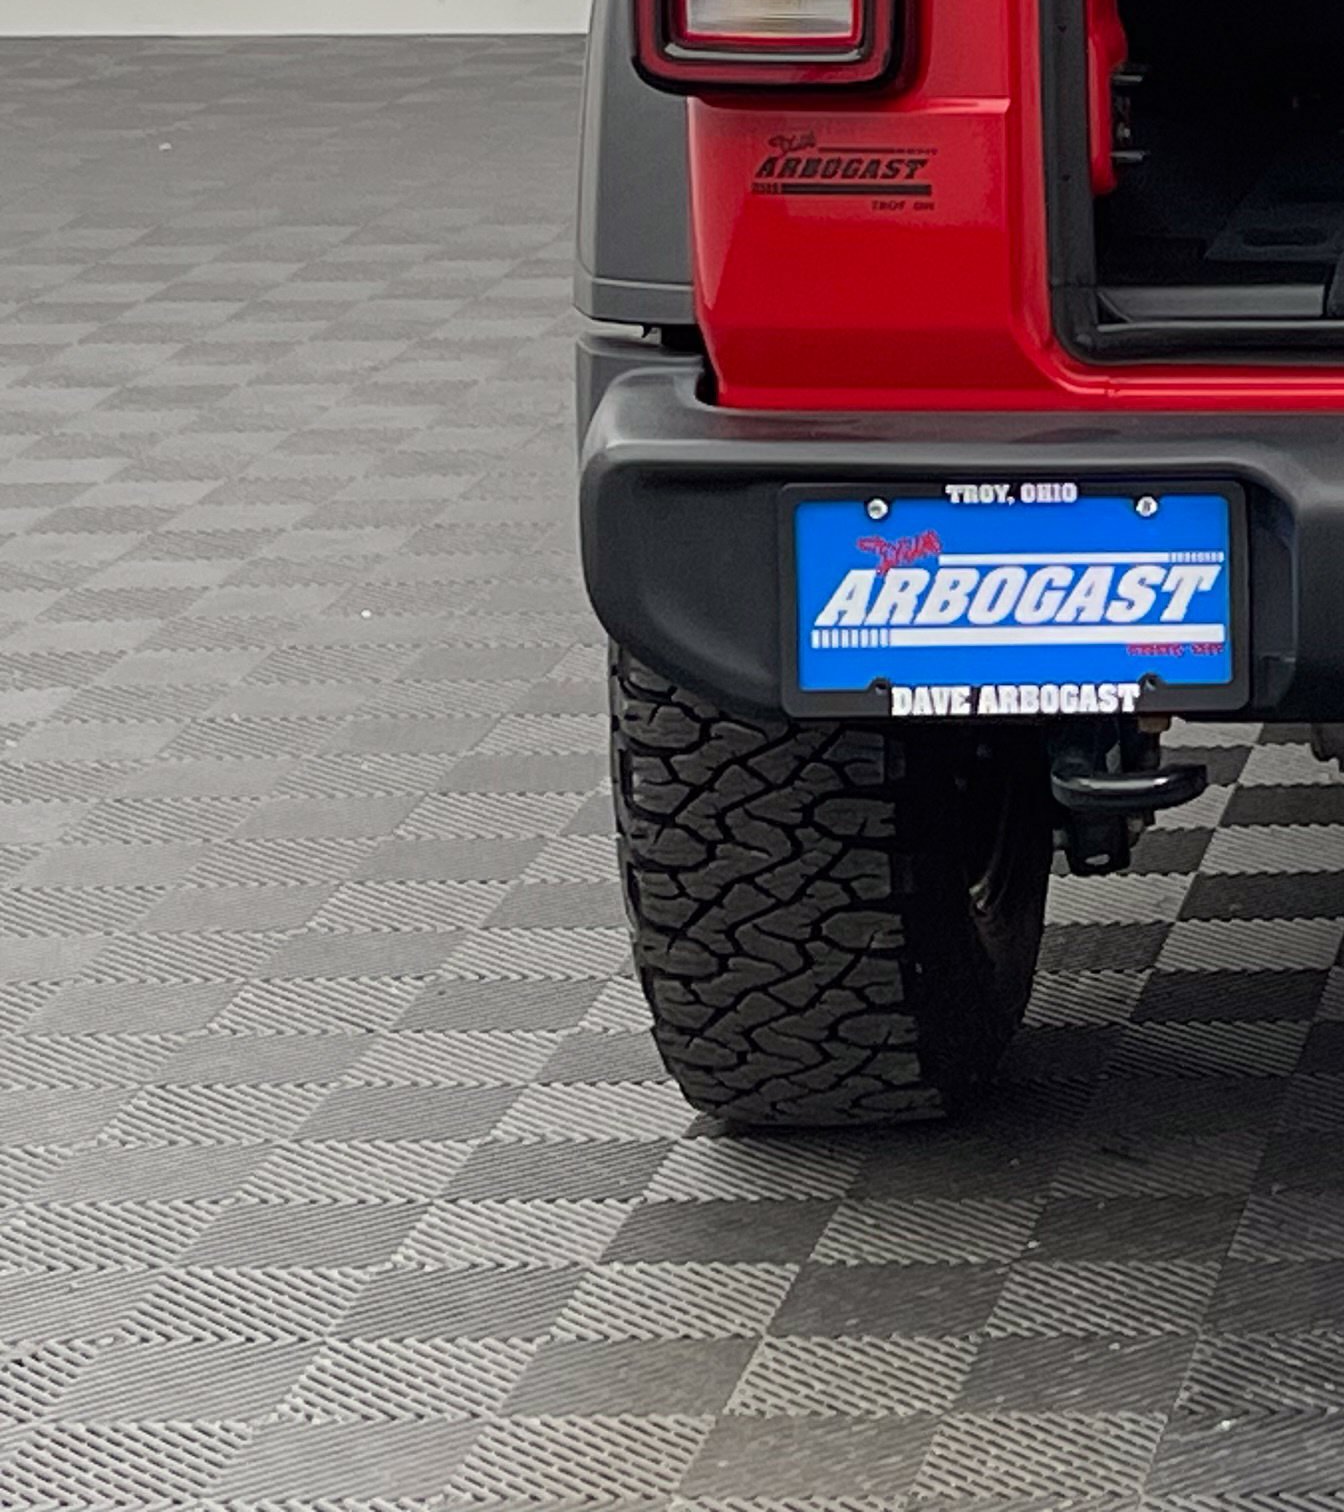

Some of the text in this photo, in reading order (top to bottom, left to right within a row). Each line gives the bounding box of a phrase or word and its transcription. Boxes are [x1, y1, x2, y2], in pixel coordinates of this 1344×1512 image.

[755, 156, 928, 180] ARBOGAST
[945, 482, 1078, 506] TROY, OHIO
[814, 565, 1224, 627] ARBOGAST
[891, 682, 1140, 717] DAVE ARBOGAST
